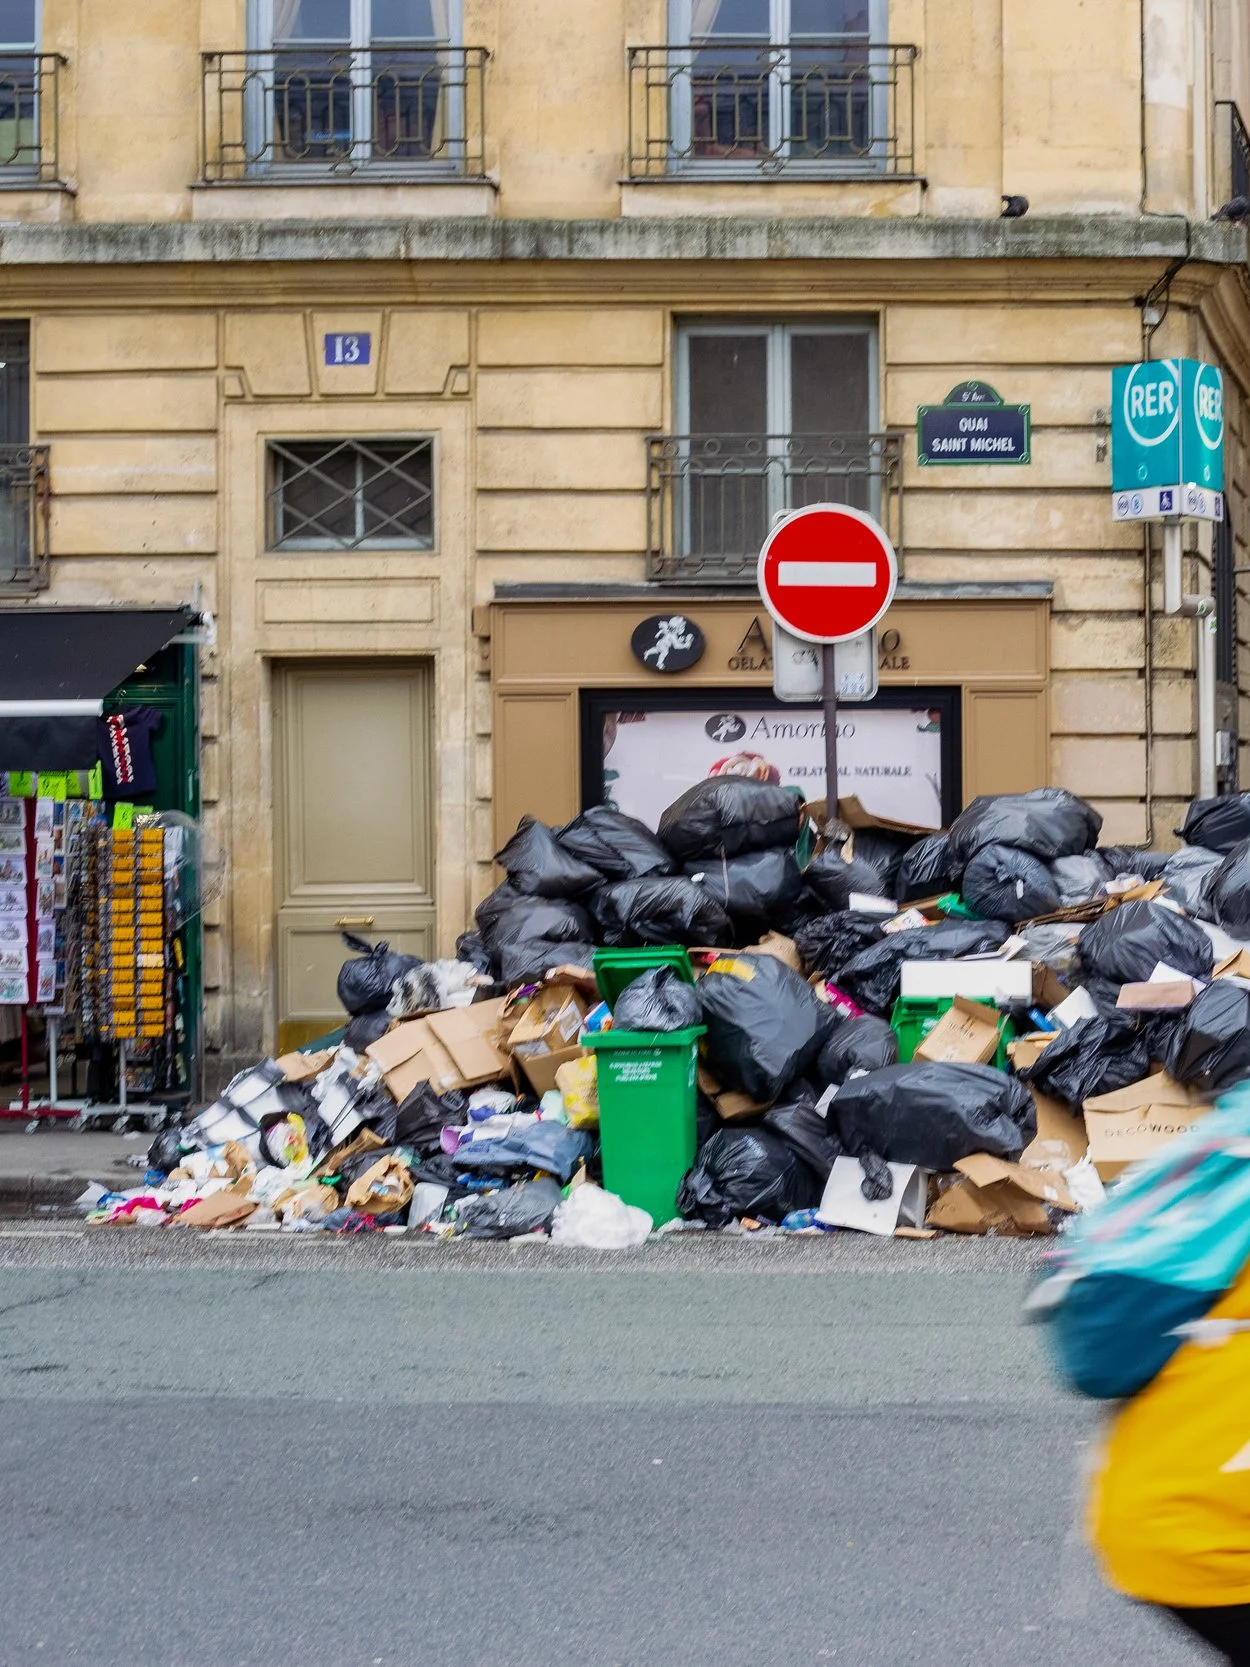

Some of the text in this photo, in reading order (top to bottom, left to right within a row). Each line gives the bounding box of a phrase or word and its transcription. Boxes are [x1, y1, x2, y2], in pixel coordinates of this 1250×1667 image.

[334, 336, 361, 363] 13
[1131, 380, 1174, 419] RER
[1199, 384, 1222, 422] RER
[958, 417, 989, 432] QUAI
[931, 437, 1016, 452] SAINT MICHEL
[728, 656, 774, 671] GELA
[789, 766, 828, 776] GELAT
[855, 766, 912, 776] NATURALE
